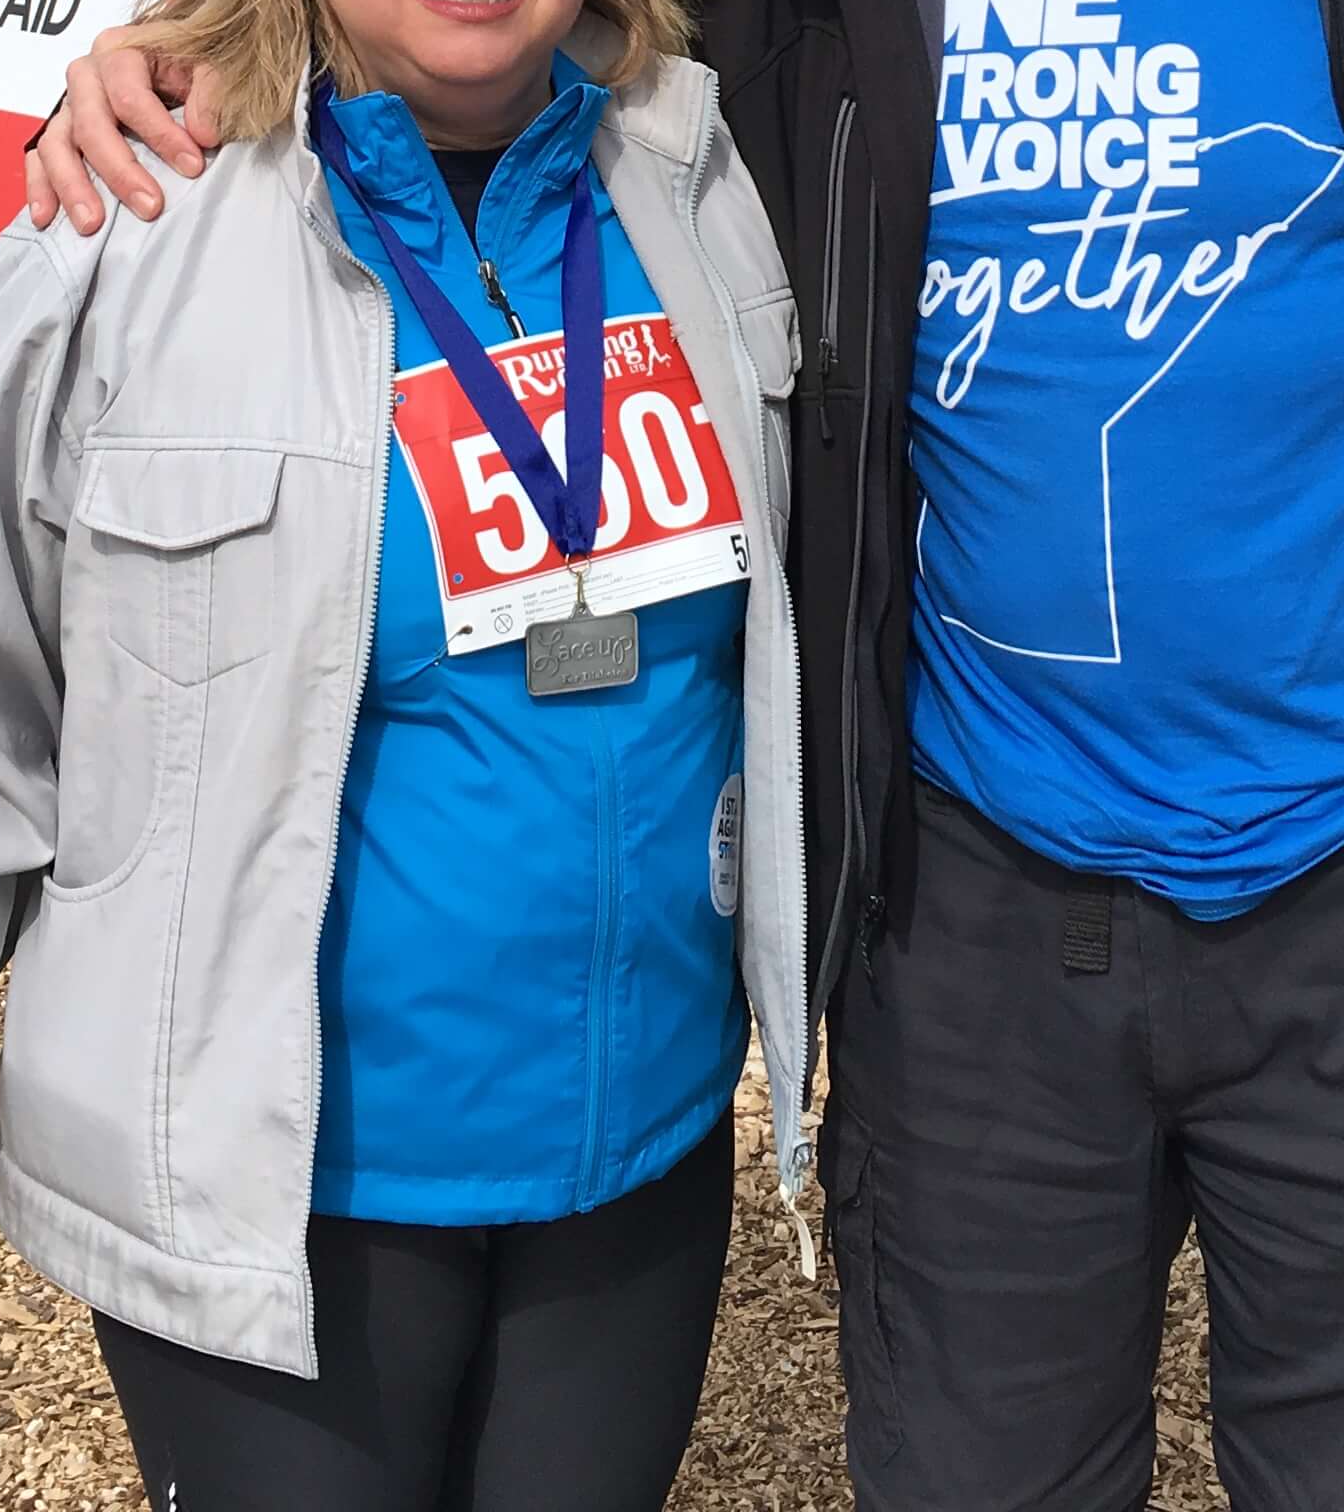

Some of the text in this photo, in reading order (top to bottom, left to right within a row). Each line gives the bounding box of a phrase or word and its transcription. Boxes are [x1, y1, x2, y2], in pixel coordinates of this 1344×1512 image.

[936, 43, 1200, 120] RONG
[940, 118, 1200, 192] VOICE
[919, 186, 1288, 408] ogether
[533, 628, 633, 677] Lace up
